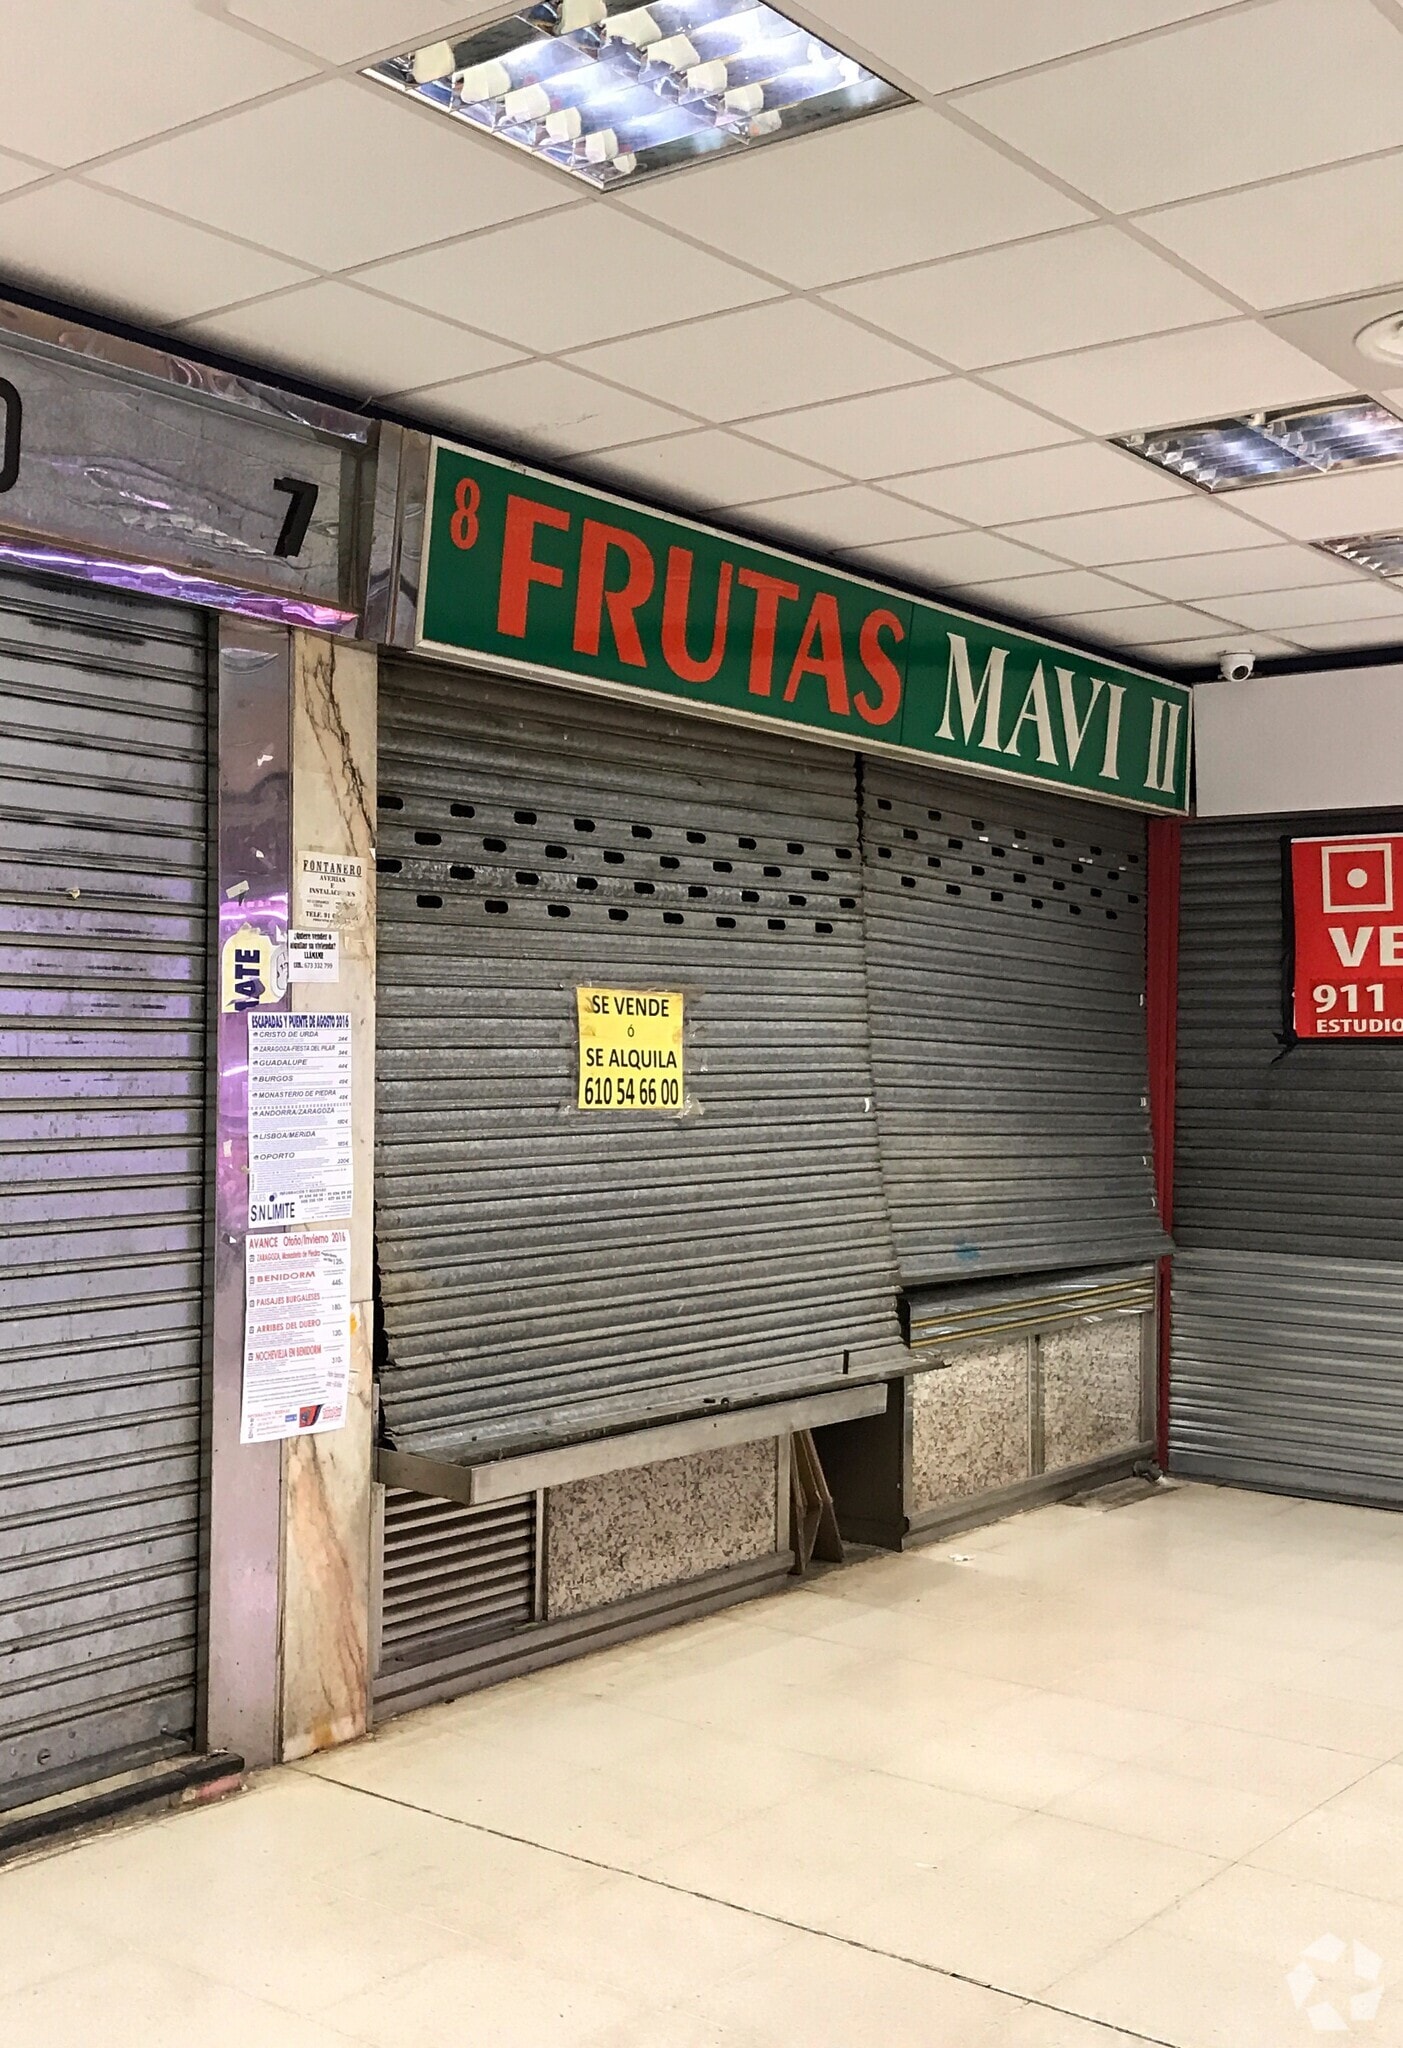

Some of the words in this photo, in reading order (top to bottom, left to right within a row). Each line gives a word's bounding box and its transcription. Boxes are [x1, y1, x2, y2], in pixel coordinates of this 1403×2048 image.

[273, 477, 319, 559] 7
[450, 478, 481, 550] 8
[496, 493, 906, 726] FRUTAS
[934, 631, 1128, 781] MAVI
[1144, 697, 1183, 795] II
[303, 860, 362, 876] FONTANERO
[320, 875, 346, 883] AVERIAS
[1328, 925, 1403, 967] VE
[592, 995, 609, 1014] SE
[614, 997, 669, 1017] VENDE
[1312, 983, 1384, 1013] 911
[251, 1015, 283, 1028] ESCAPADAS
[284, 1015, 288, 1028] Y
[289, 1015, 308, 1028] PUENTE
[309, 1015, 316, 1028] DE
[316, 1015, 335, 1028] AGOSTO
[1316, 1018, 1403, 1033] ESTUDIO
[586, 1048, 604, 1067] SE
[609, 1049, 677, 1070] ALQUILA
[585, 1077, 612, 1105] 610
[617, 1078, 635, 1104] 54
[639, 1078, 657, 1105] 66
[661, 1078, 679, 1105] 00
[259, 1152, 295, 1160] OPORTO
[267, 1202, 295, 1220] LIMITE
[249, 1237, 278, 1249] AVANCE
[283, 1234, 329, 1247] Otoño/Invierno
[257, 1271, 316, 1283] BENIDORM
[256, 1296, 285, 1306] PAISAJES
[286, 1293, 320, 1304] BURGALESES
[257, 1323, 284, 1333] ARRIBES
[285, 1321, 297, 1330] DEL
[299, 1319, 321, 1329] DUERO
[255, 1349, 288, 1361] NOCHEVIEJA
[289, 1348, 296, 1357] EN
[296, 1344, 322, 1357] BENIDORM
